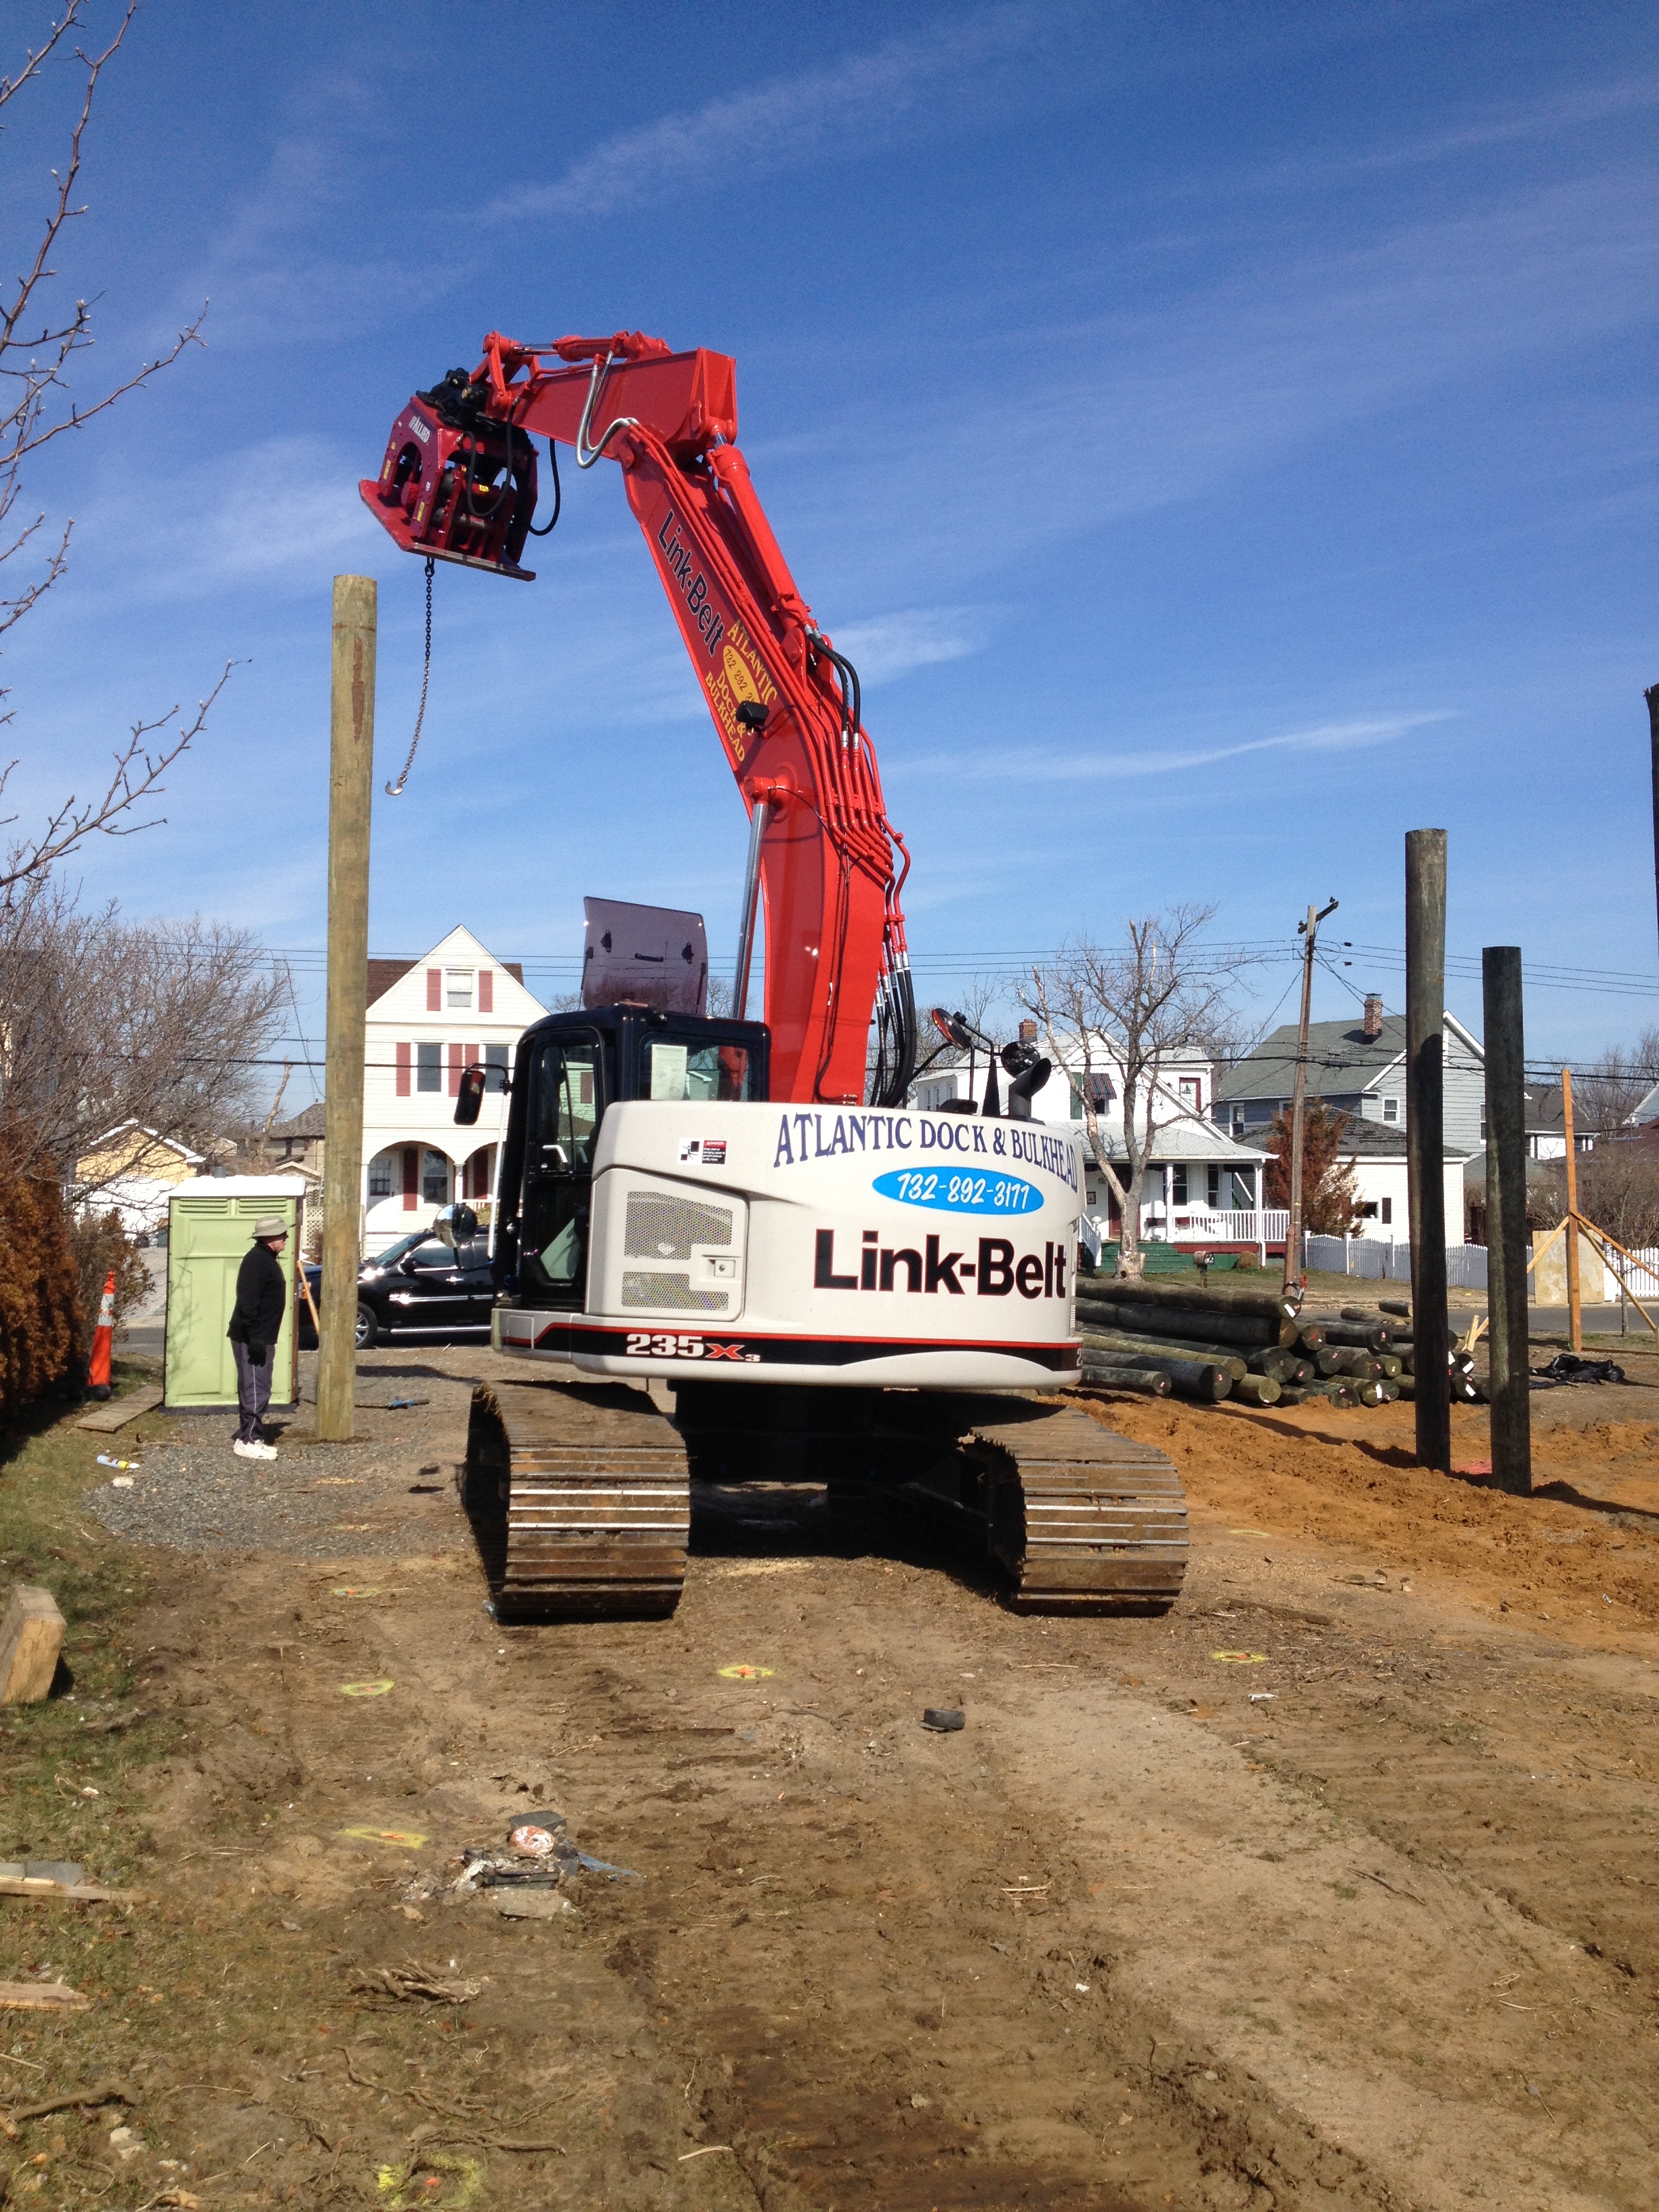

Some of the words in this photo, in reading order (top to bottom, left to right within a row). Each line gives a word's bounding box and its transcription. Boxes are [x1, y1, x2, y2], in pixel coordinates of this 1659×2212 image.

[657, 509, 724, 657] Link-Belt
[727, 619, 777, 705] ATLANTIC
[706, 672, 745, 762] BULKHEAD
[774, 1112, 912, 1168] ATLANTIC
[920, 1120, 987, 1153] DOCK
[993, 1128, 1007, 1156] &
[1010, 1129, 1078, 1194] BULKHEAD
[813, 1229, 1067, 1300] Link-Belt
